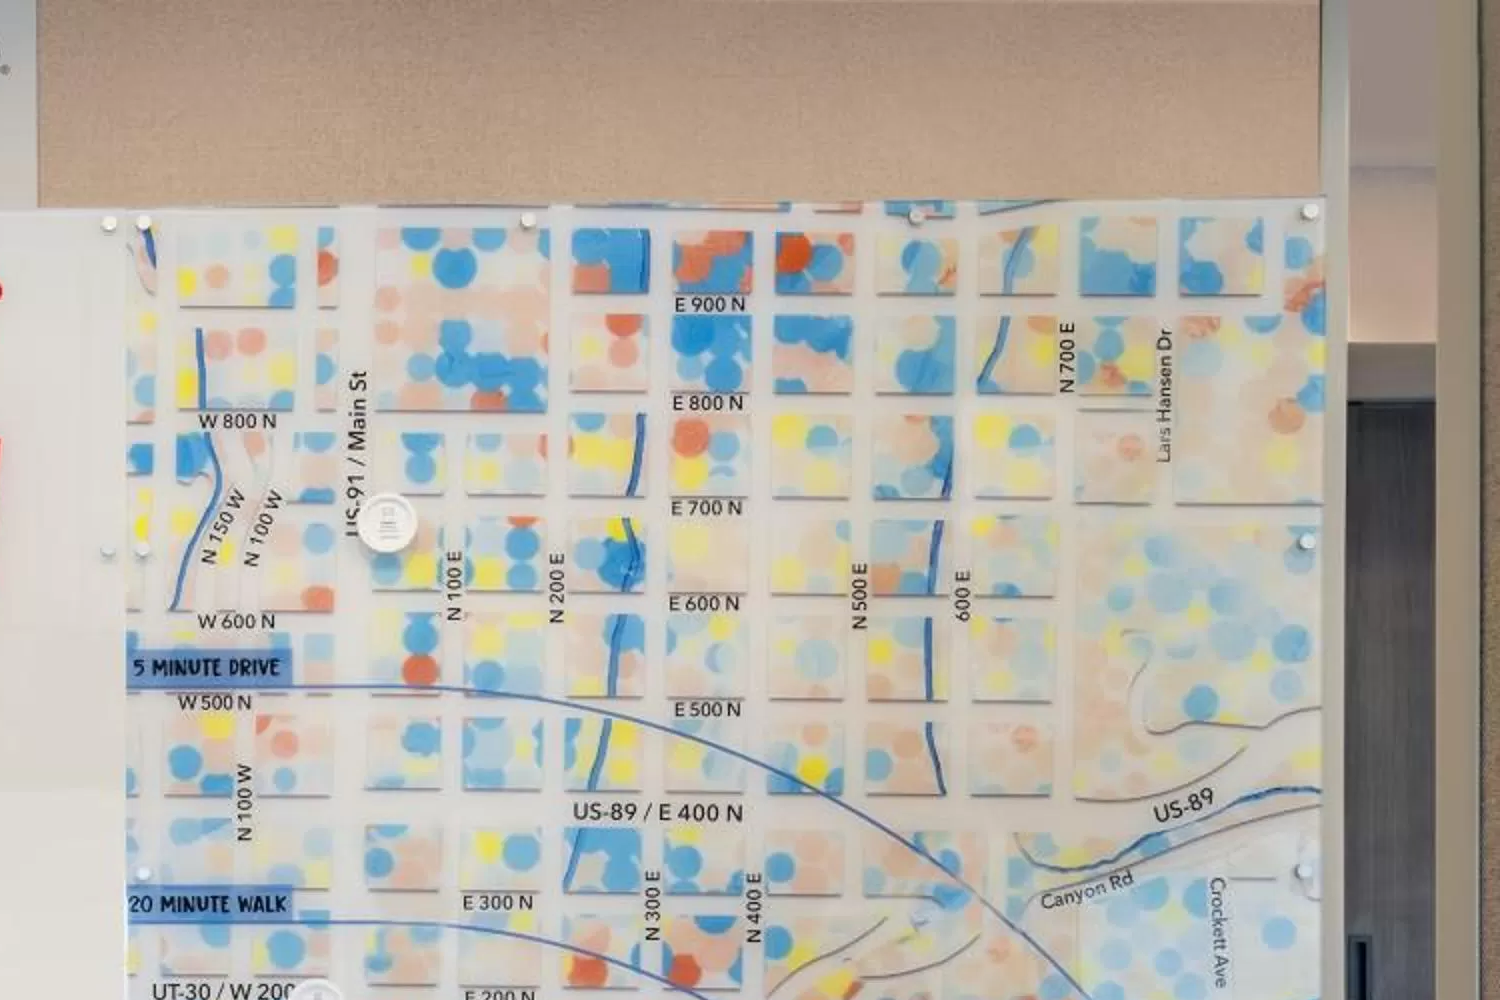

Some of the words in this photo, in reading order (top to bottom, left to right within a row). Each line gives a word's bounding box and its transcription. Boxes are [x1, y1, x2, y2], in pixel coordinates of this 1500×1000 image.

[675, 297, 686, 313] E
[690, 297, 725, 313] 900
[730, 297, 745, 313] N
[1060, 322, 1075, 334] E
[1156, 329, 1172, 351] Dr
[1060, 337, 1075, 373] 700
[349, 371, 367, 391] St
[1060, 377, 1075, 394] N
[1156, 355, 1172, 422] Hansen
[673, 396, 684, 412] E
[688, 396, 723, 412] 800
[728, 396, 743, 412] N
[199, 413, 218, 429] W
[223, 413, 258, 429] 800
[263, 413, 276, 429] N
[348, 399, 367, 451] Main
[1156, 427, 1171, 462] Lars
[264, 489, 283, 509] W
[201, 549, 217, 564] N
[209, 512, 234, 542] 150
[226, 488, 245, 509] W
[250, 513, 274, 544] 100
[244, 551, 260, 567] N
[447, 551, 463, 562] E
[447, 565, 463, 604] 100
[955, 572, 970, 582] E
[669, 596, 679, 611] E
[684, 596, 719, 611] 600
[724, 596, 740, 611] N
[955, 587, 970, 622] 600
[447, 607, 463, 621] N
[133, 659, 145, 677] 5
[152, 659, 222, 677] MINUTE
[229, 659, 280, 677] DRIVE
[178, 695, 197, 710] W
[200, 695, 234, 710] 500
[238, 695, 251, 710] N
[237, 764, 253, 783] W
[237, 786, 253, 822] 100
[573, 803, 639, 822] US-89
[659, 803, 671, 822] E
[677, 803, 719, 822] 400
[725, 803, 743, 822] N
[1153, 787, 1214, 822] US-89
[237, 827, 253, 841] N
[646, 871, 661, 883] E
[1041, 882, 1106, 909] Canyon
[1109, 868, 1134, 891] Rd
[129, 896, 153, 913] 20
[160, 896, 231, 913] MINUTE
[236, 896, 287, 913] WALK
[646, 885, 661, 921] 300
[1210, 877, 1228, 950] Crockett
[646, 925, 661, 941] N
[1214, 955, 1229, 988] Ave
[152, 984, 210, 1000] UT-30
[230, 984, 251, 1000] W
